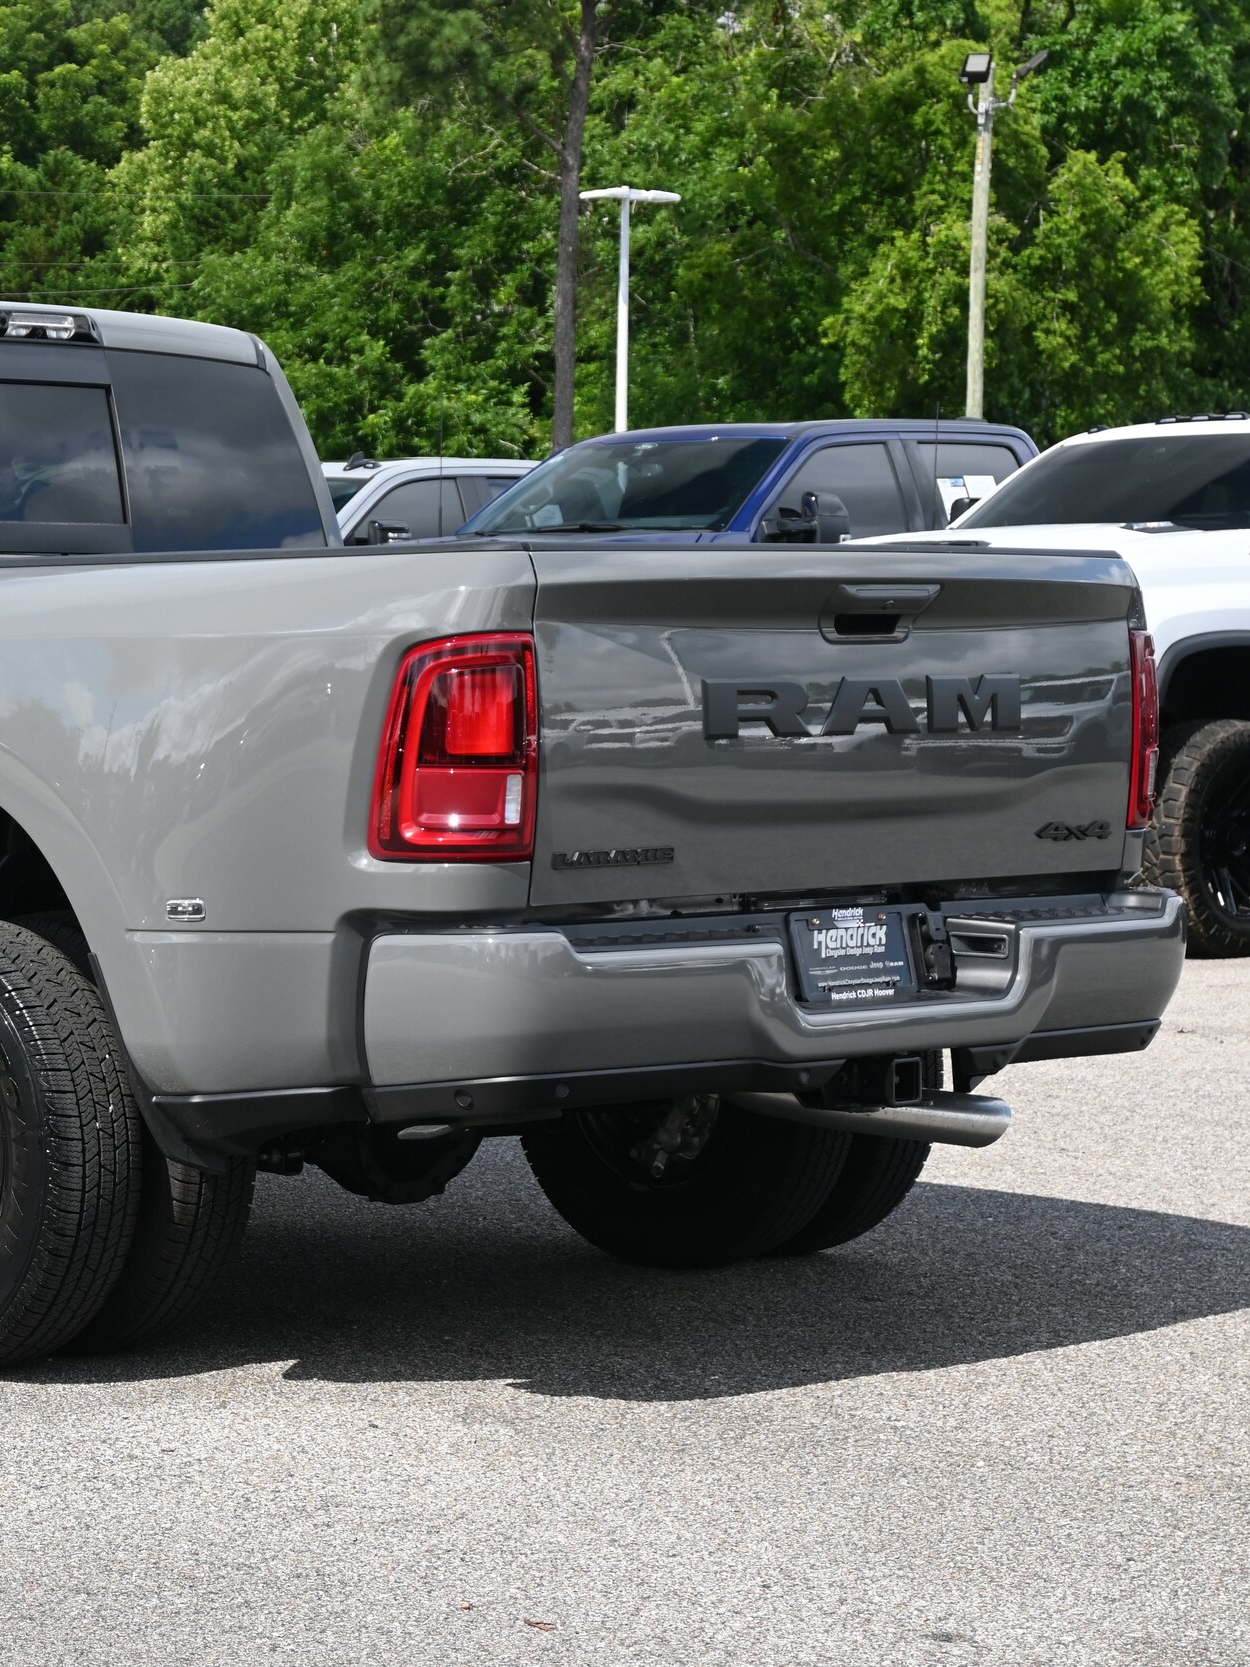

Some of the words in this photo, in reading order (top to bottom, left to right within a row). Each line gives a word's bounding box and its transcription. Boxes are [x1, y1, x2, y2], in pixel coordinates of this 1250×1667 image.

[701, 673, 1021, 740] RAM
[552, 847, 674, 870] LARAMIE
[832, 907, 863, 919] Hendrick
[813, 925, 887, 958] Hendrick
[826, 948, 846, 958] Chrysler
[847, 947, 862, 957] Dodge
[862, 946, 873, 955] Jeep
[874, 945, 885, 953] Ram
[869, 961, 883, 969] Jeep
[831, 990, 857, 1000] Hendrick
[857, 989, 874, 998] CDJR
[874, 988, 895, 997] Hoover
